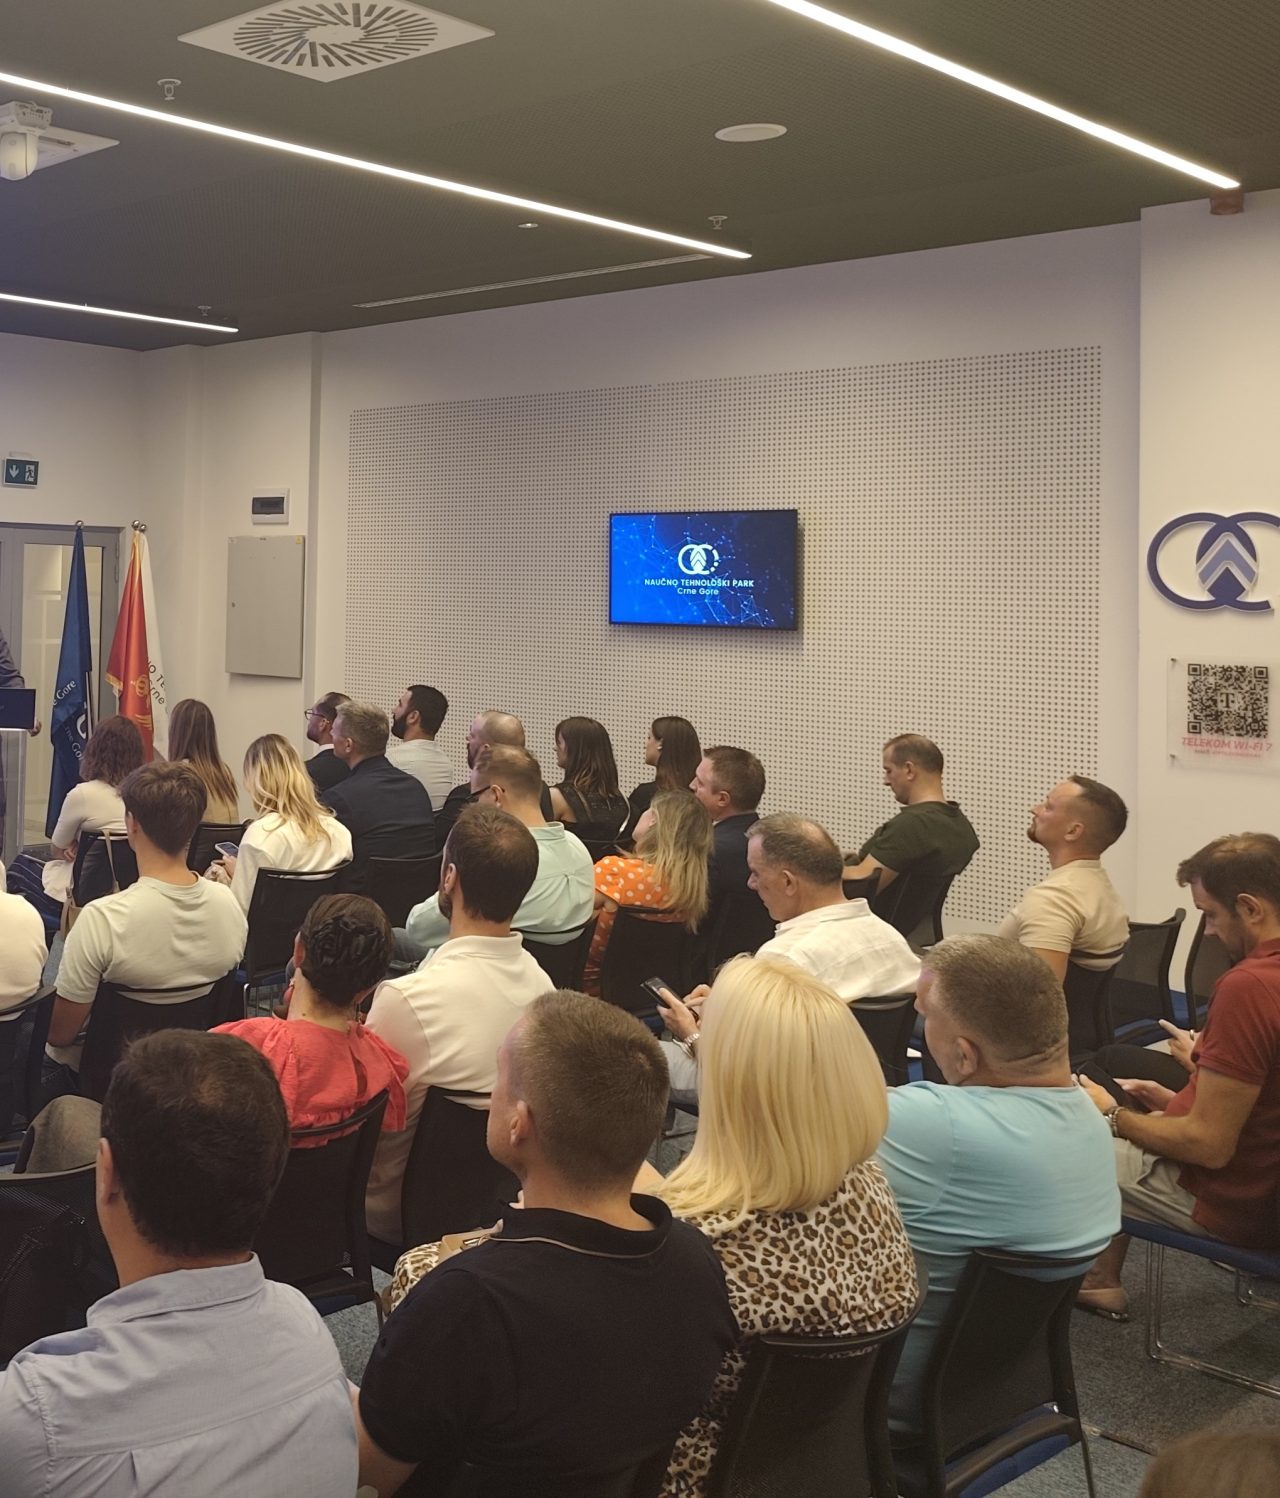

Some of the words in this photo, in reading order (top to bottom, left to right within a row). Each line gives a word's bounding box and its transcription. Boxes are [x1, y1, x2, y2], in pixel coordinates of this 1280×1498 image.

[644, 577, 678, 586] NAUČNO
[681, 577, 730, 587] TEHNOLOŠKI
[732, 579, 754, 587] PARK
[56, 680, 77, 699] Gore
[1182, 737, 1230, 748] TELEKOM
[1234, 740, 1263, 751] WI-FI
